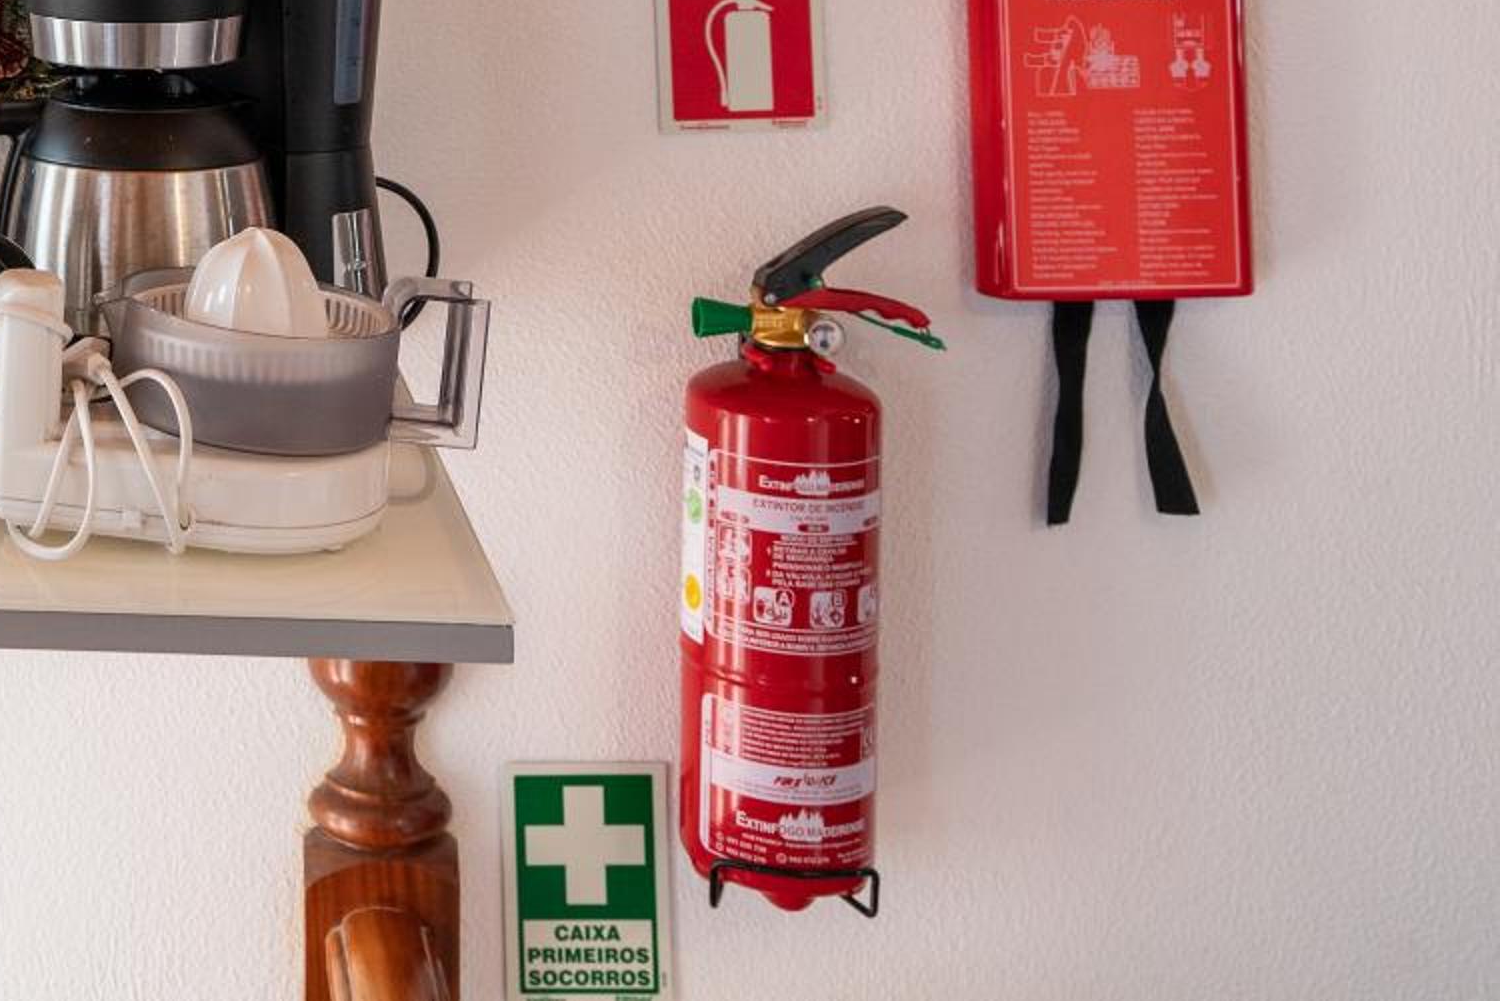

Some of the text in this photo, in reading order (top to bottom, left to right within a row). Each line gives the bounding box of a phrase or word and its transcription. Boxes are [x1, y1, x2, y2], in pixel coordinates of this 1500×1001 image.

[554, 924, 621, 942] CAIXA
[527, 947, 650, 964] PRIMEIROS
[528, 969, 651, 987] SOCORROS
